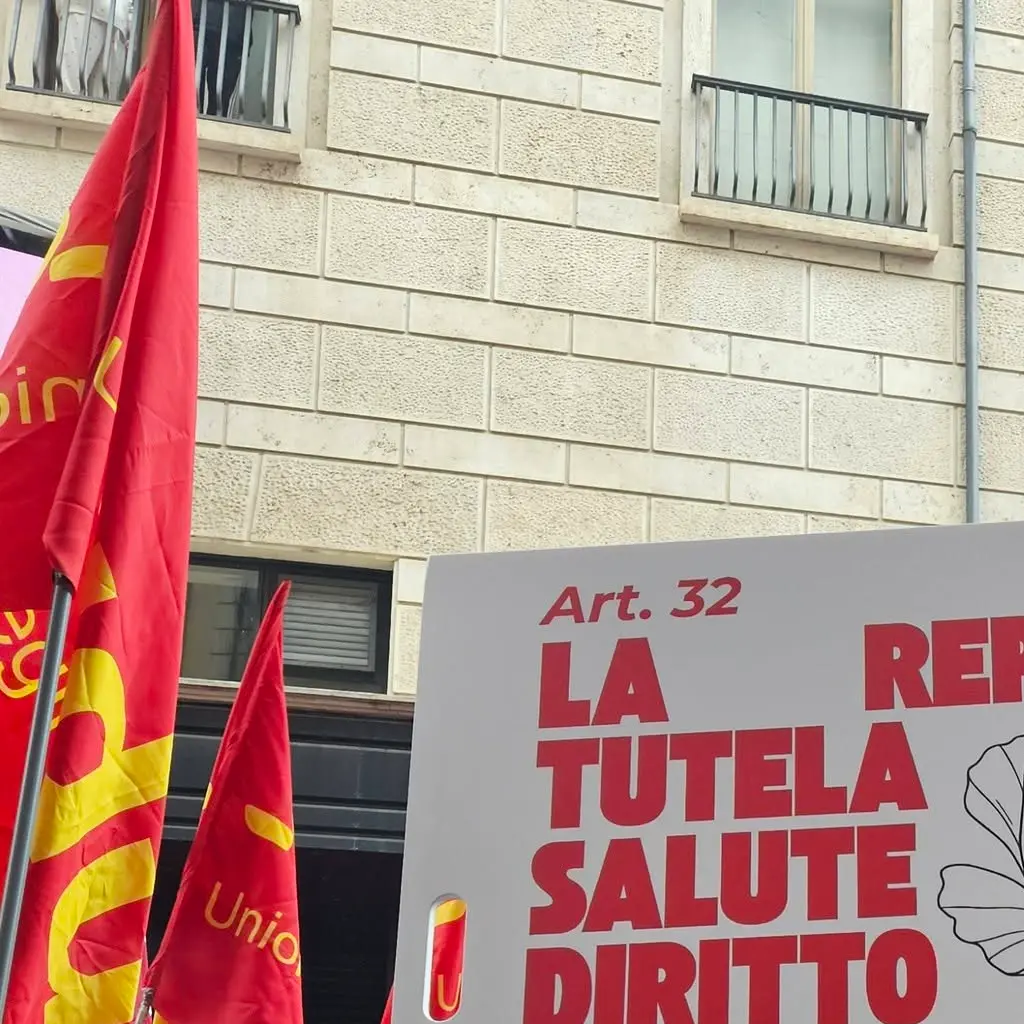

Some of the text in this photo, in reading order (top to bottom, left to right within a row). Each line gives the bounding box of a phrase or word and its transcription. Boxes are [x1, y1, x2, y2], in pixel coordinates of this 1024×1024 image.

[538, 576, 743, 626] Art. 32
[538, 636, 669, 729] LA
[536, 720, 929, 830] TUTELA
[530, 825, 918, 936] SALUTE
